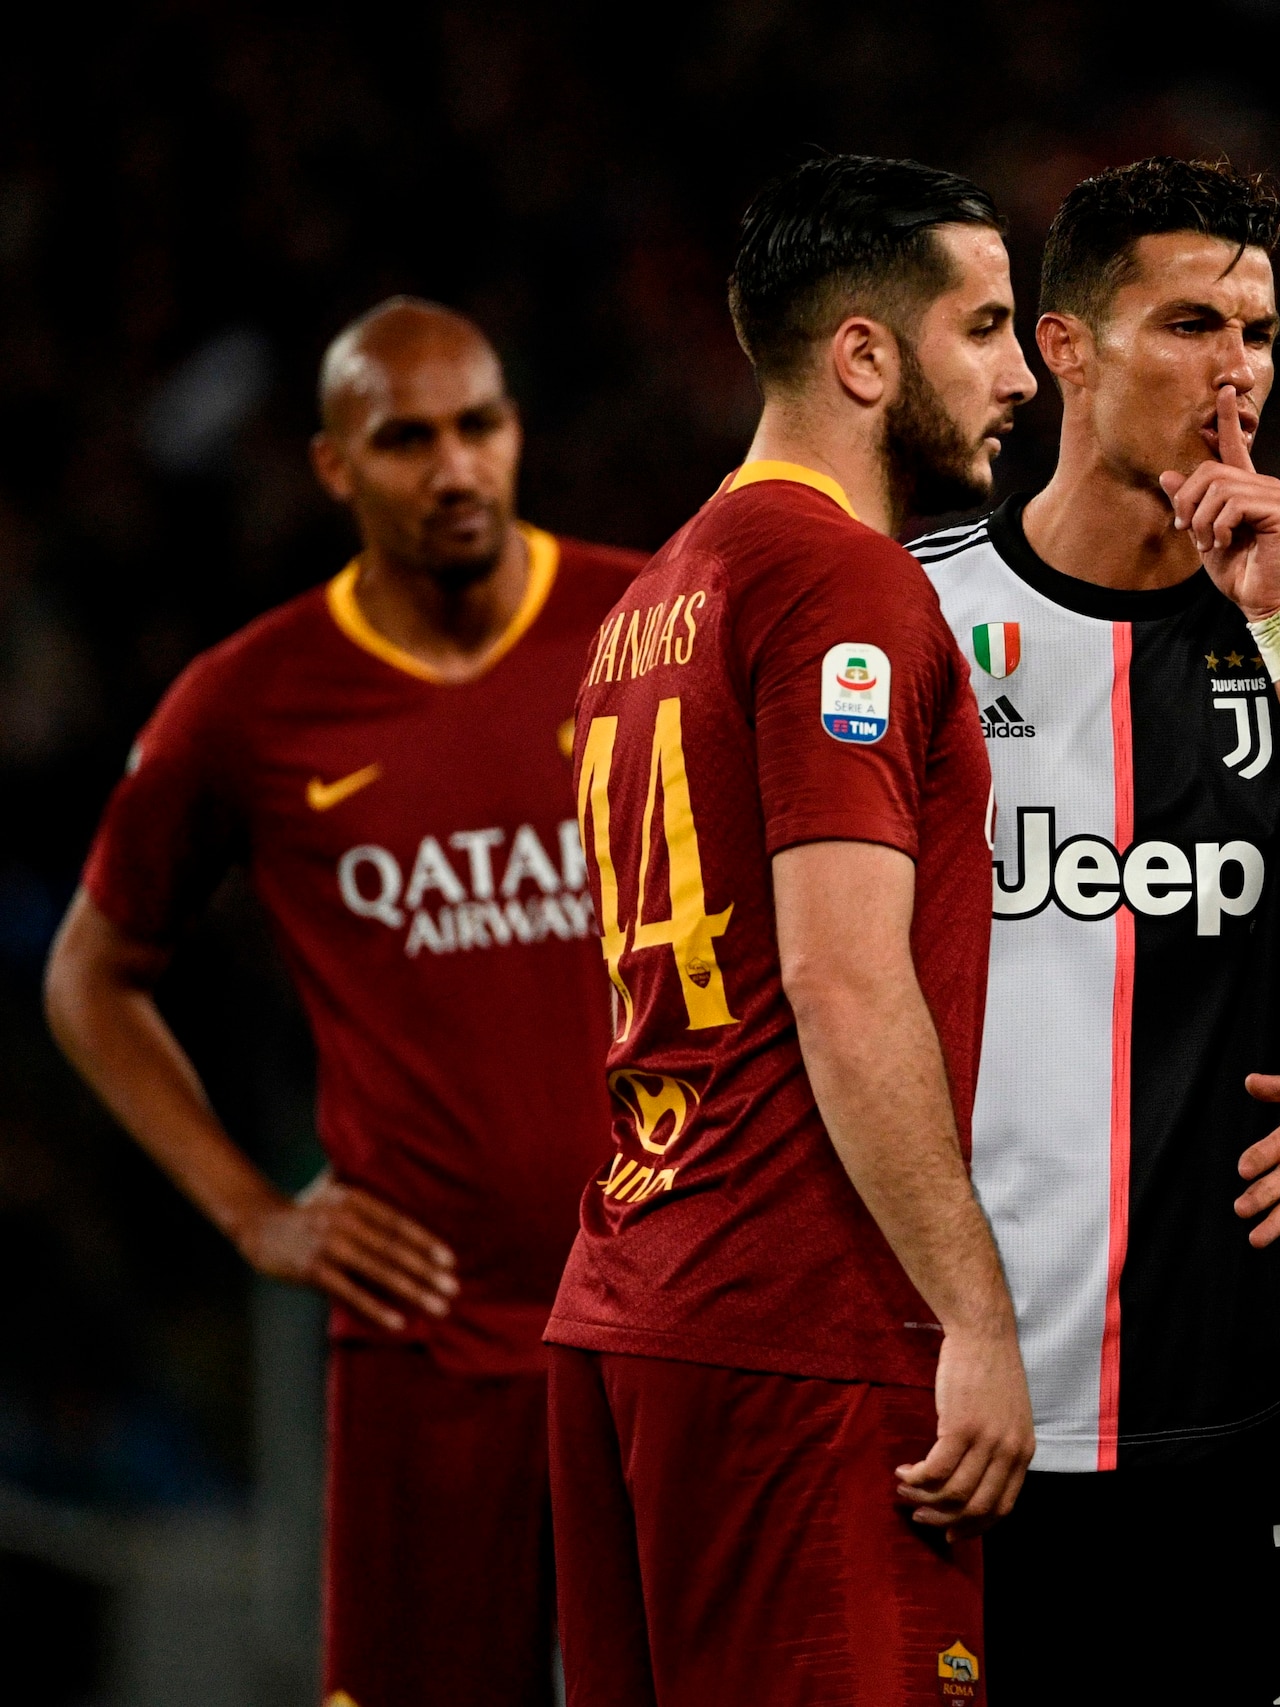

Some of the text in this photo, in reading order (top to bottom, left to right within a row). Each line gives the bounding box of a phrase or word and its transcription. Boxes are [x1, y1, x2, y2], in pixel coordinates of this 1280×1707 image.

[1211, 677, 1267, 693] JUVENTUS
[834, 700, 876, 714] SERIE A
[849, 720, 878, 737] TIM
[981, 722, 1036, 738] didas
[577, 697, 742, 1044] 44
[992, 806, 1266, 937] Jeep
[405, 891, 600, 958] AIRWAY
[943, 1683, 974, 1696] ROMA
